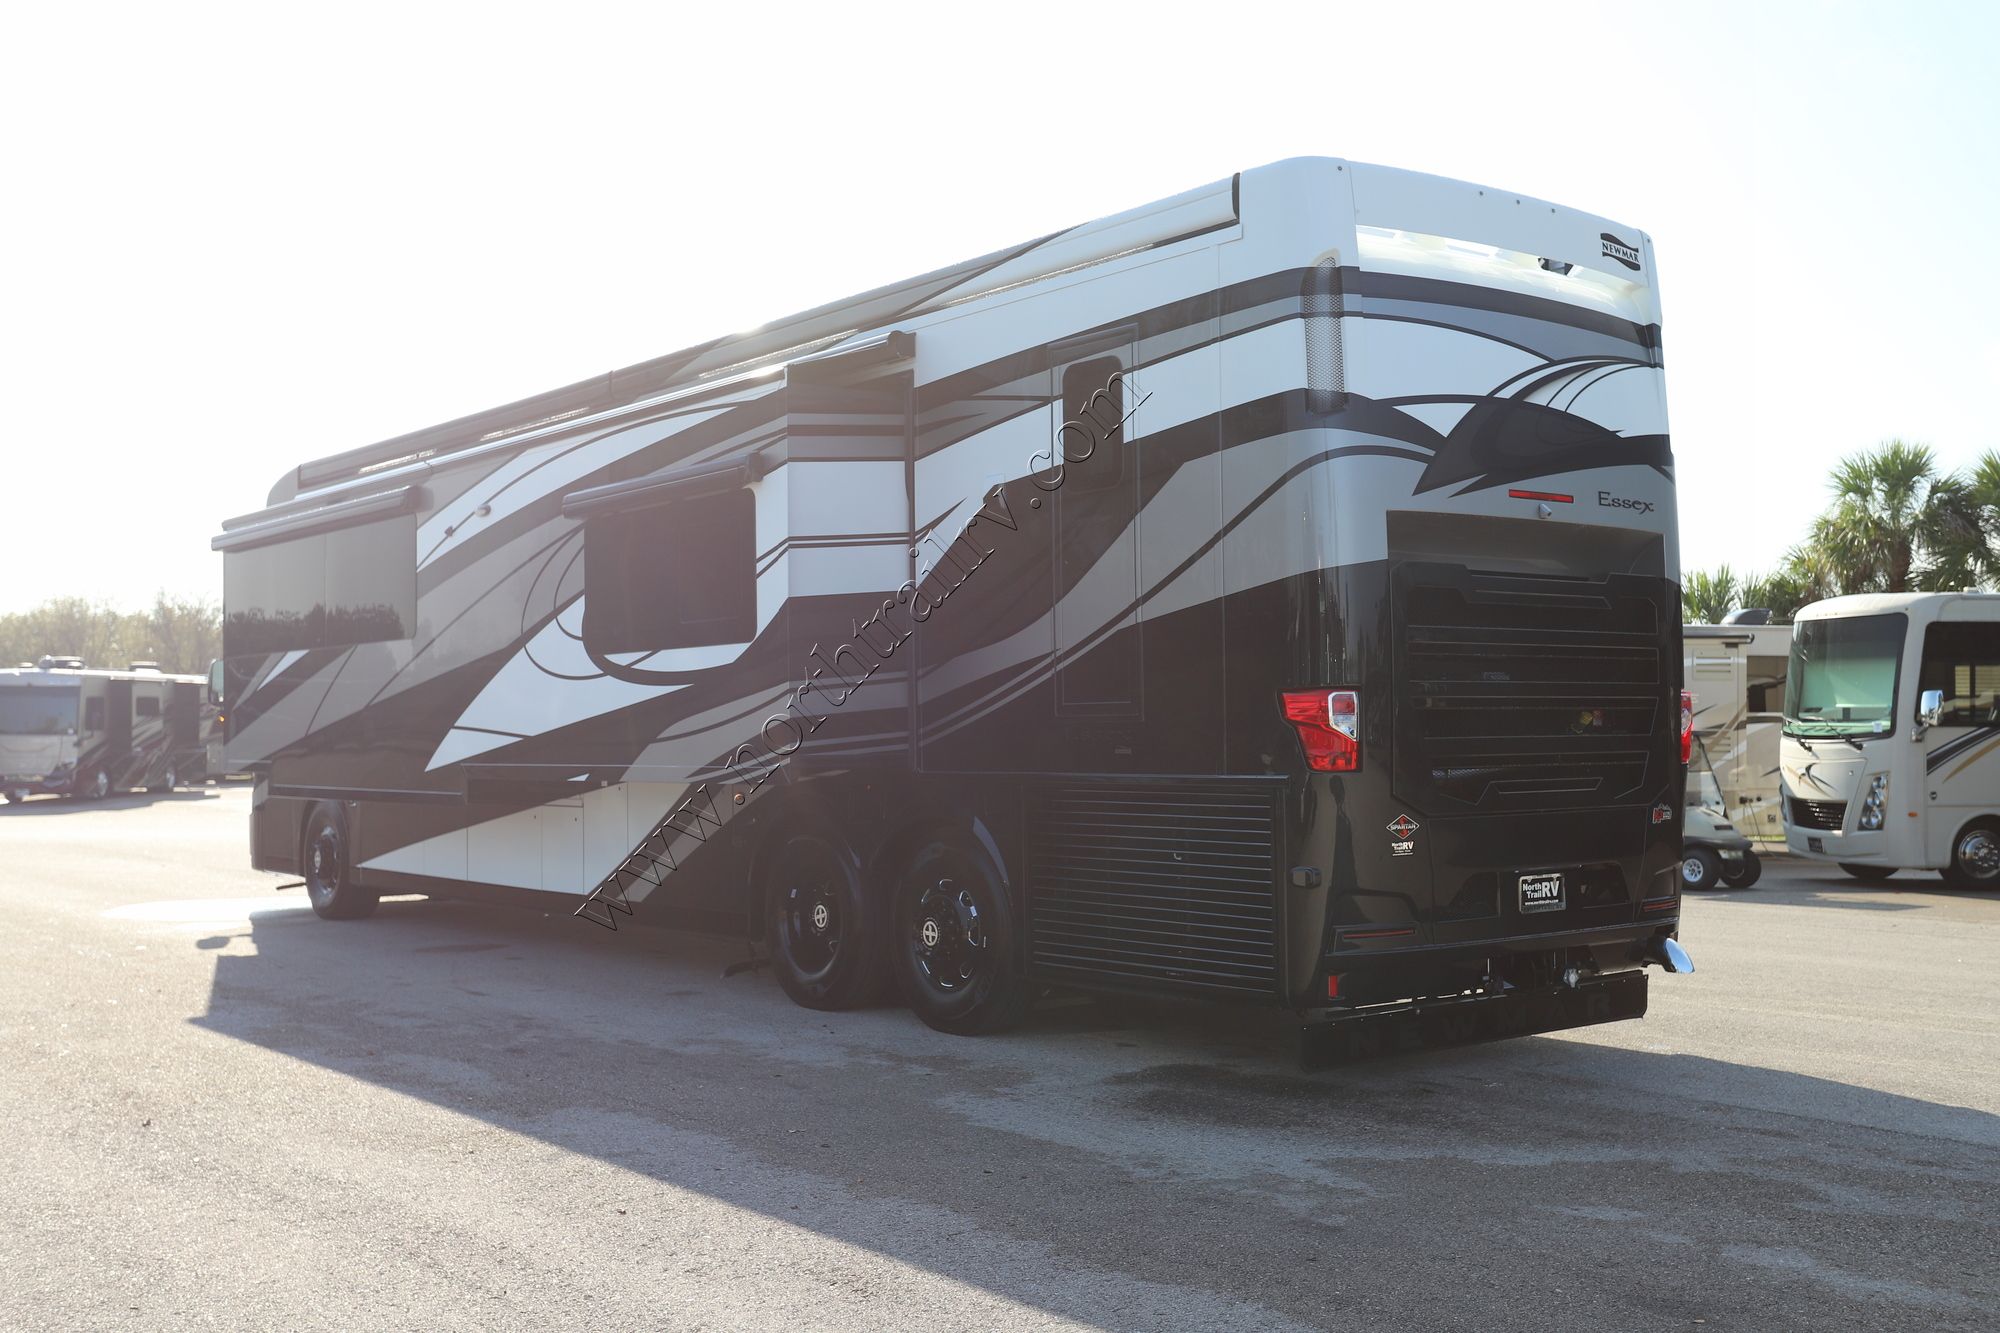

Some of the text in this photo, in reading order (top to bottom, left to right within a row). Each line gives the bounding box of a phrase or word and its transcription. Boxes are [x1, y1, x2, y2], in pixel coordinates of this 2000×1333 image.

[1602, 242, 1639, 263] NEWMAR
[1598, 491, 1654, 515] Essex
[1403, 842, 1414, 850] RV
[1523, 882, 1541, 891] North
[1542, 881, 1560, 897] RV
